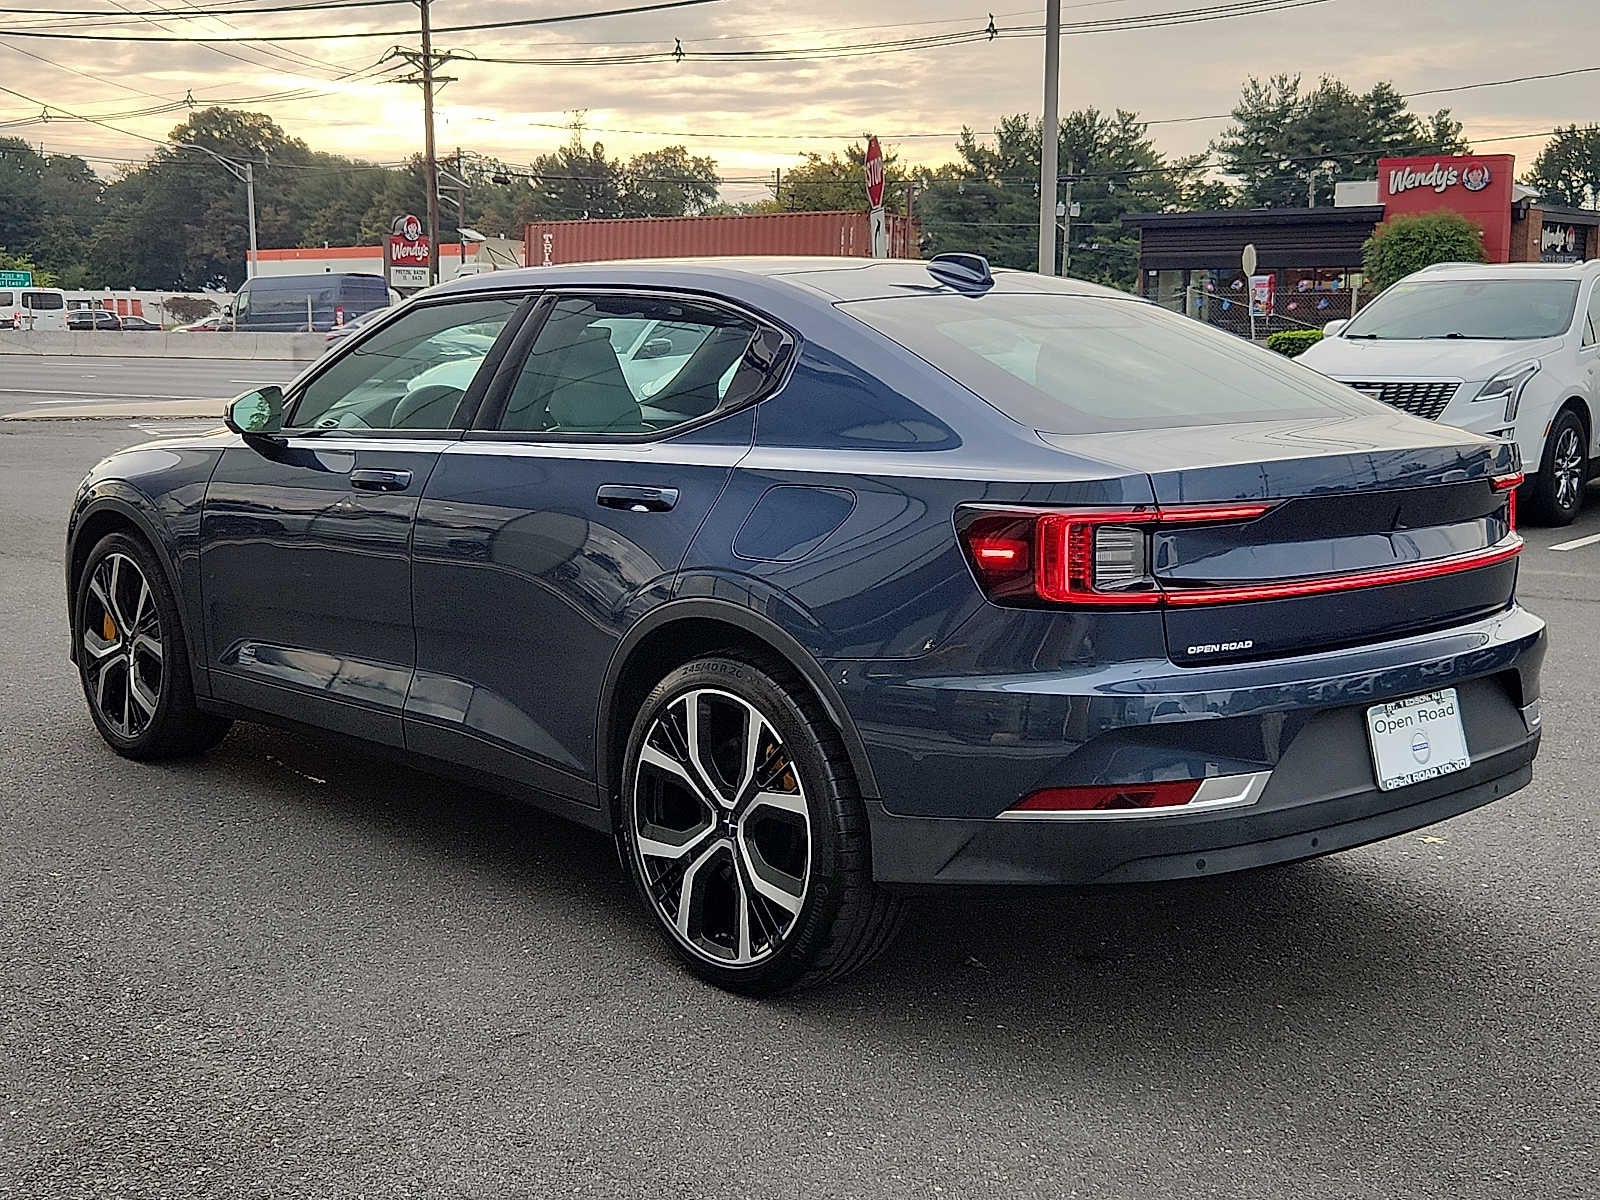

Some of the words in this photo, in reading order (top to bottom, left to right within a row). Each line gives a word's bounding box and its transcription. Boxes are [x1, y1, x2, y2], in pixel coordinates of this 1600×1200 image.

[866, 157, 882, 187] STOP
[1389, 162, 1458, 195] Wendy's
[392, 240, 429, 261] Wendy's
[1541, 224, 1565, 252] Wendy's
[1187, 644, 1220, 655] OPEN
[1221, 640, 1253, 651] ROAD
[1374, 715, 1414, 735] Open
[1417, 703, 1455, 723] Road
[1386, 774, 1413, 789] OPEN
[1413, 767, 1439, 782] ROAD
[1438, 759, 1468, 774] VOLVO
